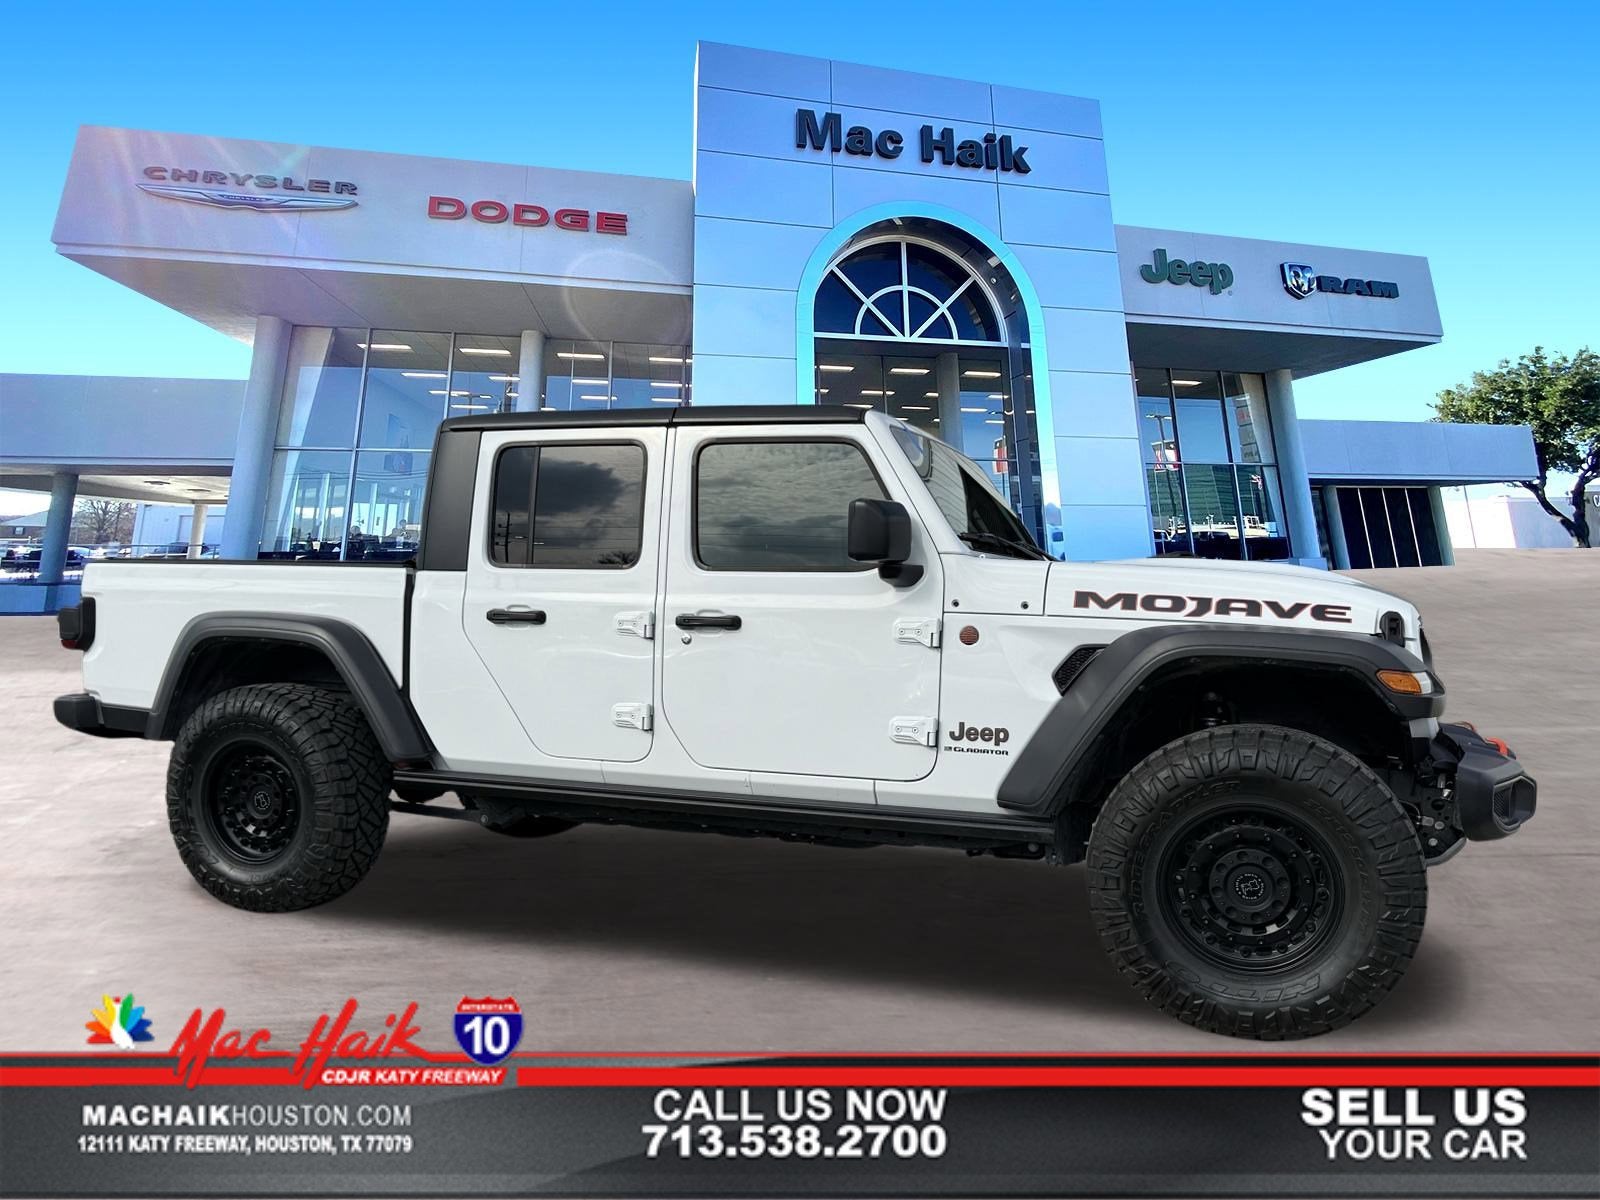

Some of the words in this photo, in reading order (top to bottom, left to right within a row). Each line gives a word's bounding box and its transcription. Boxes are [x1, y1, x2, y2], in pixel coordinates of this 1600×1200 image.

[796, 108, 904, 159] Mac
[920, 124, 1032, 174] Haik
[143, 166, 358, 196] CHRYSLER
[428, 196, 628, 236] DODGE
[1139, 248, 1234, 295] Jeep
[1316, 275, 1400, 299] RAM
[1073, 590, 1353, 624] MOJAVE
[948, 721, 1010, 746] Jeep
[953, 746, 1009, 756] GLADIATOR
